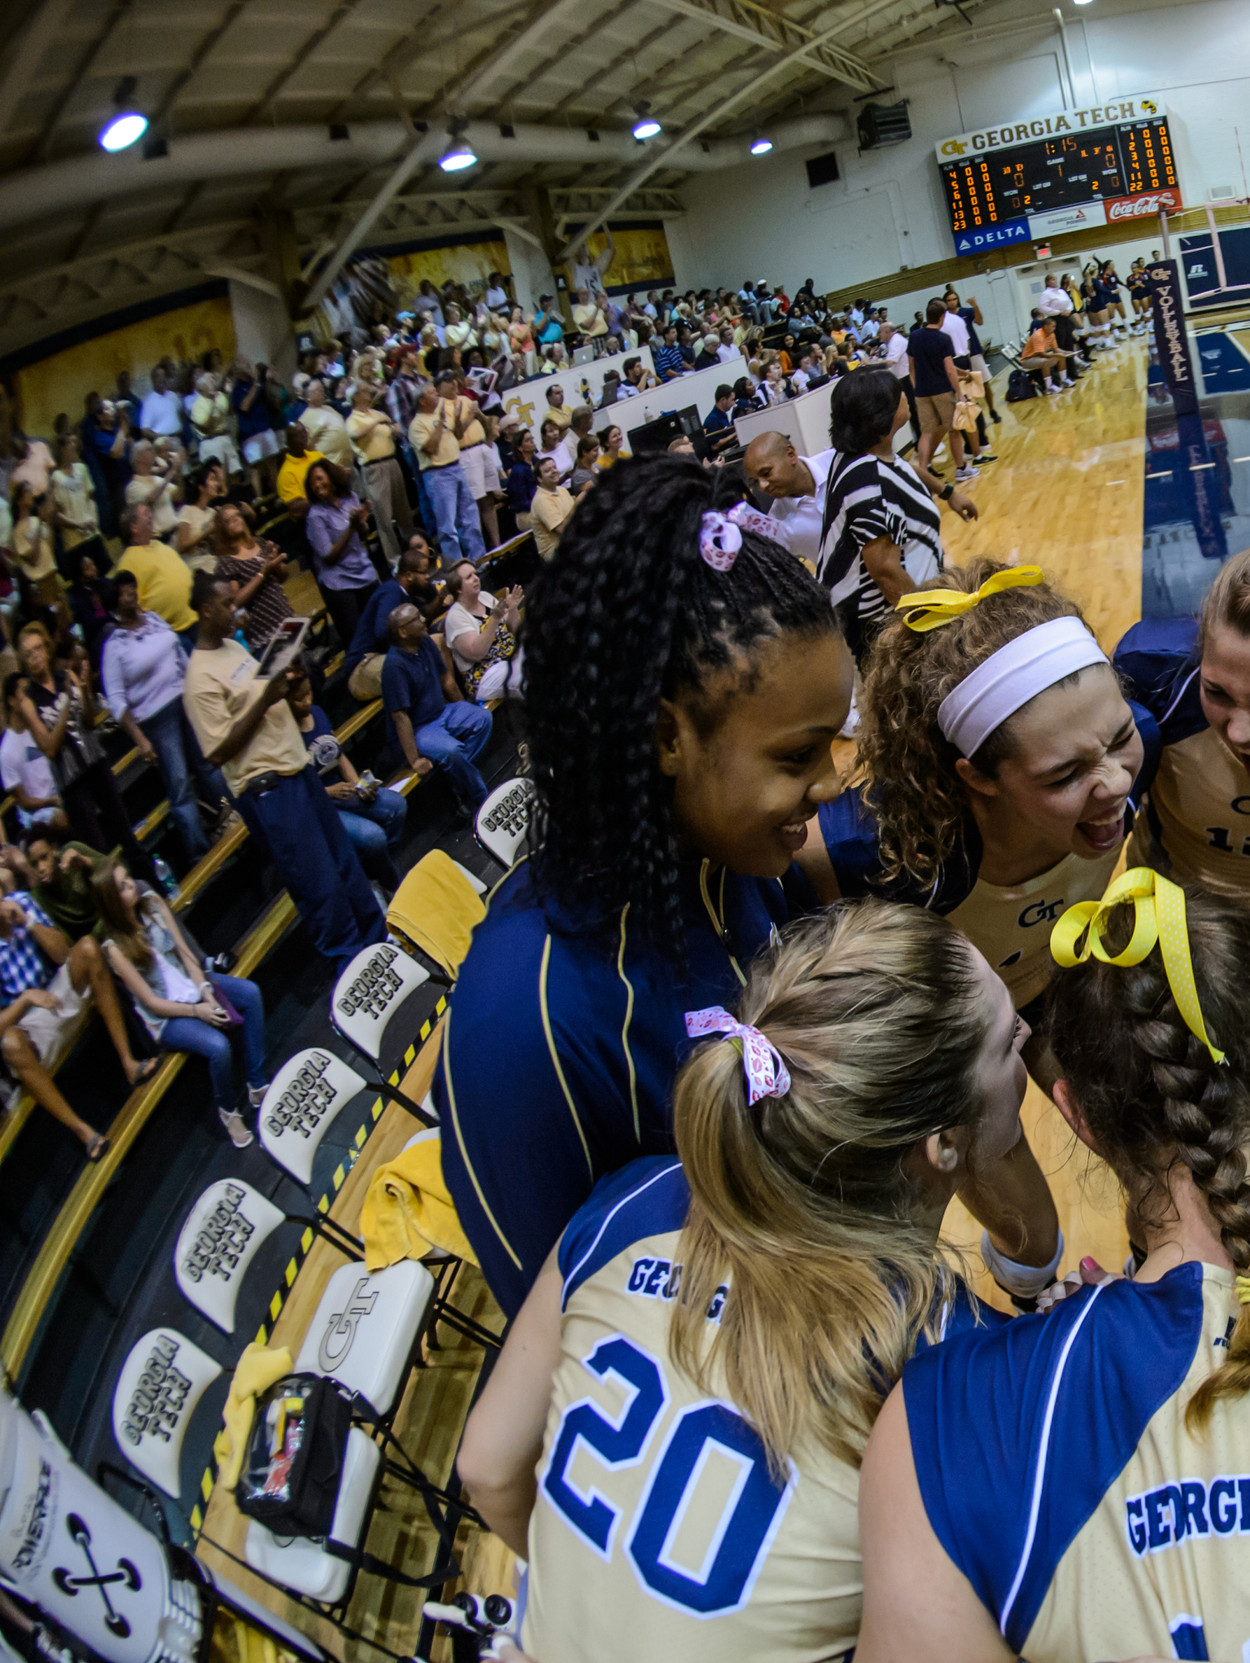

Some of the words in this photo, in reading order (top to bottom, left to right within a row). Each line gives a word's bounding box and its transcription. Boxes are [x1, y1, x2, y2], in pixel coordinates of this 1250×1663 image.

[971, 115, 1072, 150] GEORGIA
[1074, 101, 1136, 127] TECH
[1129, 132, 1134, 140] 1
[1142, 129, 1150, 139] 0
[1159, 126, 1166, 136] 0
[1129, 141, 1135, 151] 2
[1144, 139, 1152, 148] 0
[1160, 136, 1168, 146] 0
[1131, 151, 1138, 161] 3
[1146, 148, 1154, 158] 0
[1162, 146, 1170, 155] 0
[949, 171, 957, 179] 4
[965, 166, 972, 176] 0
[980, 163, 988, 172] 0
[1131, 162, 1140, 170] 4
[1147, 158, 1156, 168] 0
[1164, 156, 1172, 165] 0
[1131, 172, 1142, 181] 11
[1149, 168, 1158, 178] 0
[1166, 165, 1173, 175] 0
[951, 181, 959, 190] 5
[967, 176, 974, 186] 0
[982, 172, 990, 182] 0
[953, 191, 961, 200] 6
[969, 186, 976, 196] 0
[984, 182, 992, 192] 0
[1091, 181, 1099, 190] 2
[1129, 181, 1143, 192] 22
[1151, 178, 1159, 188] 0
[1167, 175, 1175, 185] 0
[952, 200, 963, 210] 11
[970, 196, 978, 206] 0
[986, 192, 994, 202] 0
[1023, 195, 1031, 205] 2
[954, 210, 964, 220] 13
[972, 206, 980, 215] 0
[988, 202, 995, 212] 0
[953, 220, 966, 231] 23
[974, 216, 982, 226] 0
[990, 212, 997, 222] 0
[974, 225, 1026, 247] DELTA
[1156, 285, 1189, 382] VOLLEYBALL
[1017, 898, 1065, 929] GT
[336, 942, 399, 1018] GEORGIA
[361, 968, 405, 1022] TECH
[262, 1051, 333, 1139] GEORGIA
[290, 1078, 338, 1139] TECH
[181, 1182, 247, 1283] GEORGIA
[207, 1211, 256, 1282] TECH
[318, 1277, 379, 1373] GT
[120, 1334, 181, 1446] GEORGIA
[146, 1366, 193, 1443] TECH
[540, 1333, 799, 1620] 20
